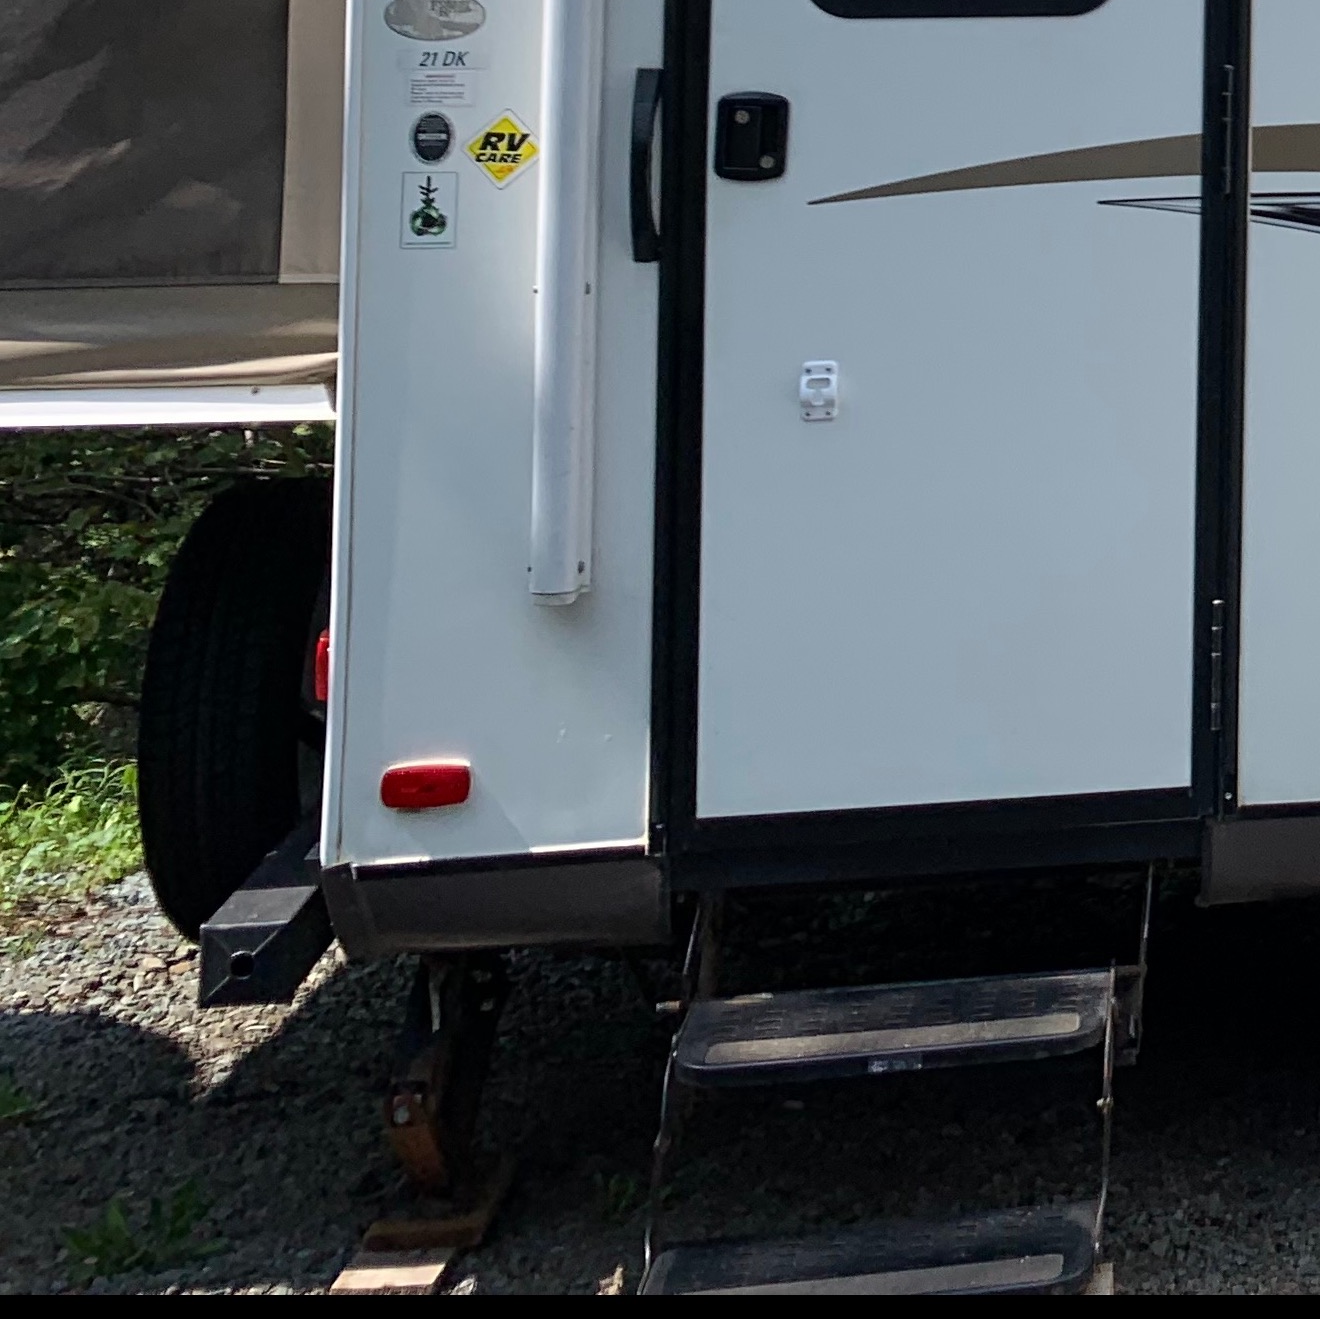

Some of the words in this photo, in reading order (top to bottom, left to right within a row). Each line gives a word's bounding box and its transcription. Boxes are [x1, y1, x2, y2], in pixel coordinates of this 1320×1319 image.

[419, 51, 438, 67] 21
[442, 51, 470, 67] DK
[479, 132, 530, 152] RV
[475, 153, 522, 164] CARE
